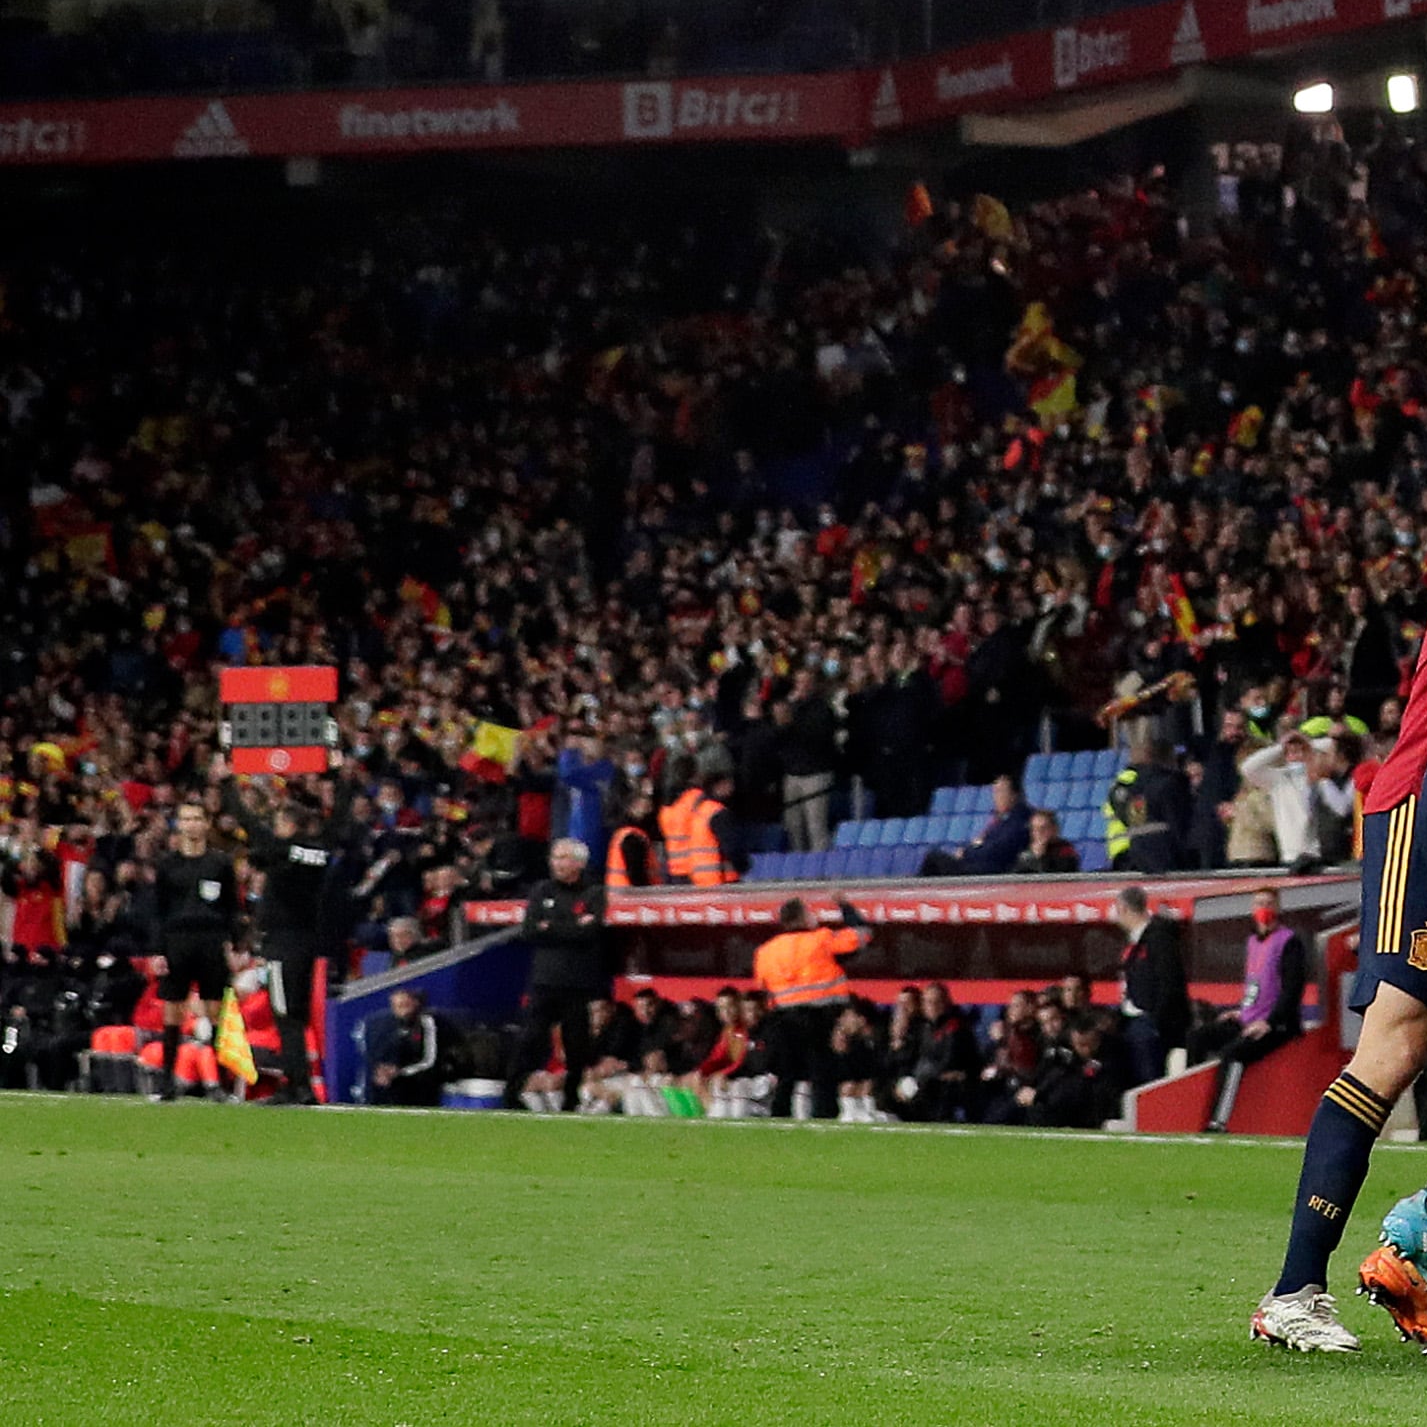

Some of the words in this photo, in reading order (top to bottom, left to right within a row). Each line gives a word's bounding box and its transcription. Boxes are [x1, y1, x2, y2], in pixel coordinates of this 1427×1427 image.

[339, 99, 520, 137] finetwork
[678, 89, 780, 127] Bitci
[1308, 1195, 1342, 1221] RFEF
